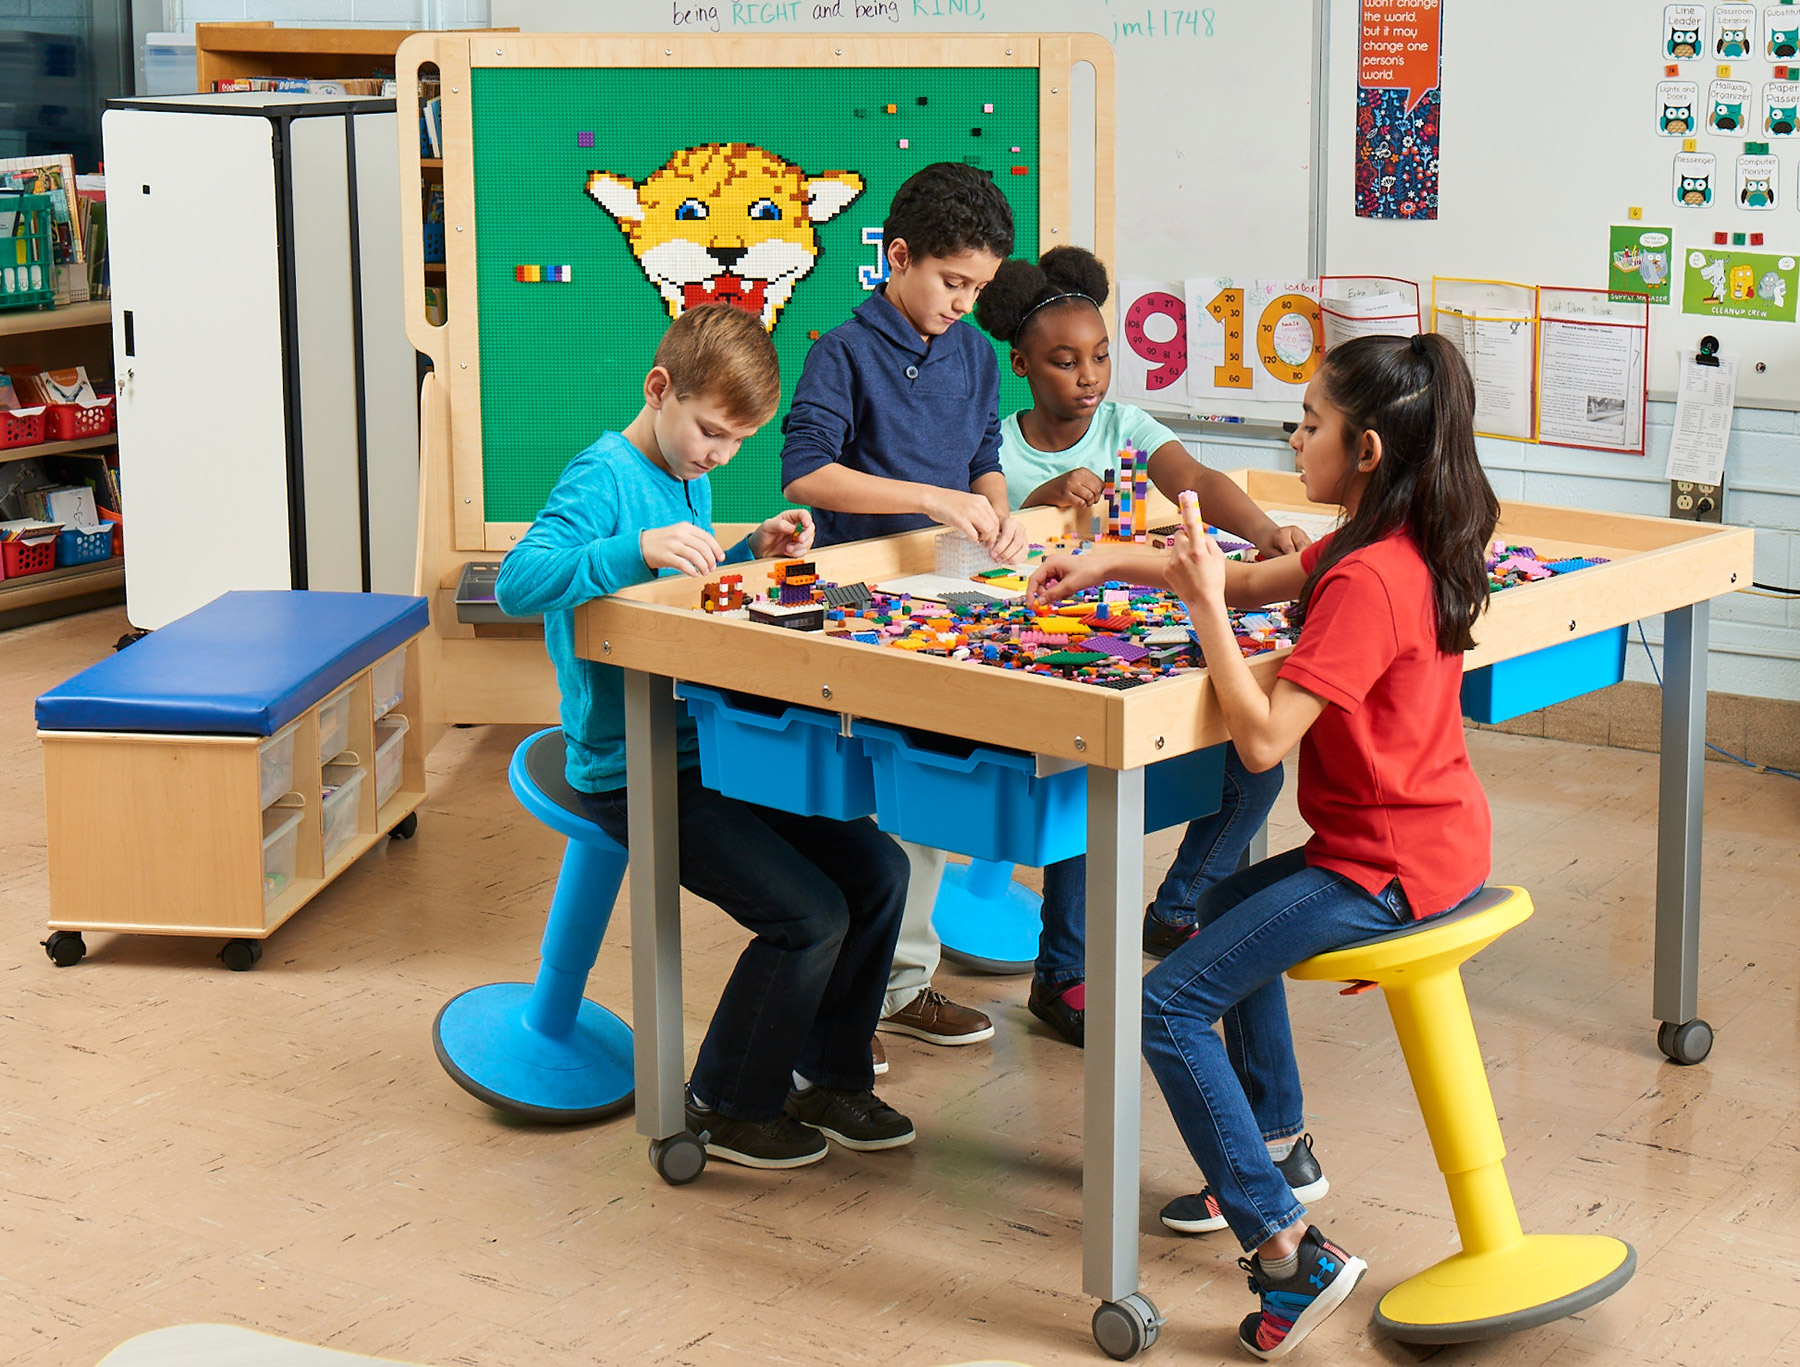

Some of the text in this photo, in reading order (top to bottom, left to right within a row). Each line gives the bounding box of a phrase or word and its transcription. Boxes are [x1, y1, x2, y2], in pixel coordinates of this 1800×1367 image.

[1675, 6, 1695, 15] Line
[673, 1, 720, 32] being
[733, 1, 799, 25] RIGHT
[812, 0, 844, 20] and
[855, 0, 900, 22] being
[1364, 12, 1380, 21] the
[1668, 16, 1702, 26] Leader
[1363, 26, 1417, 39] but it may
[1363, 41, 1428, 54] change one
[1363, 55, 1405, 67] person's
[1363, 70, 1394, 80] world.
[1660, 86, 1680, 94] Lights
[1716, 82, 1747, 93] Hallway
[1769, 83, 1799, 93] Paper
[1710, 90, 1751, 101] Organizer
[1738, 158, 1777, 166] Computer
[1147, 298, 1155, 306] 18
[1225, 294, 1235, 302] 20
[1213, 305, 1221, 313] 10
[1281, 301, 1292, 309] 80
[1230, 309, 1240, 317] 30
[1711, 306, 1767, 317] CLEANUP CREW
[1262, 324, 1272, 332] 70
[1229, 331, 1239, 339] 40
[1147, 347, 1156, 355] 90
[1163, 351, 1171, 359] 81
[1230, 353, 1239, 361] 50
[1264, 356, 1277, 364] 120
[1169, 367, 1179, 376] 63
[1154, 376, 1164, 384] 72
[1229, 374, 1239, 383] 60
[1292, 372, 1302, 380] 110
